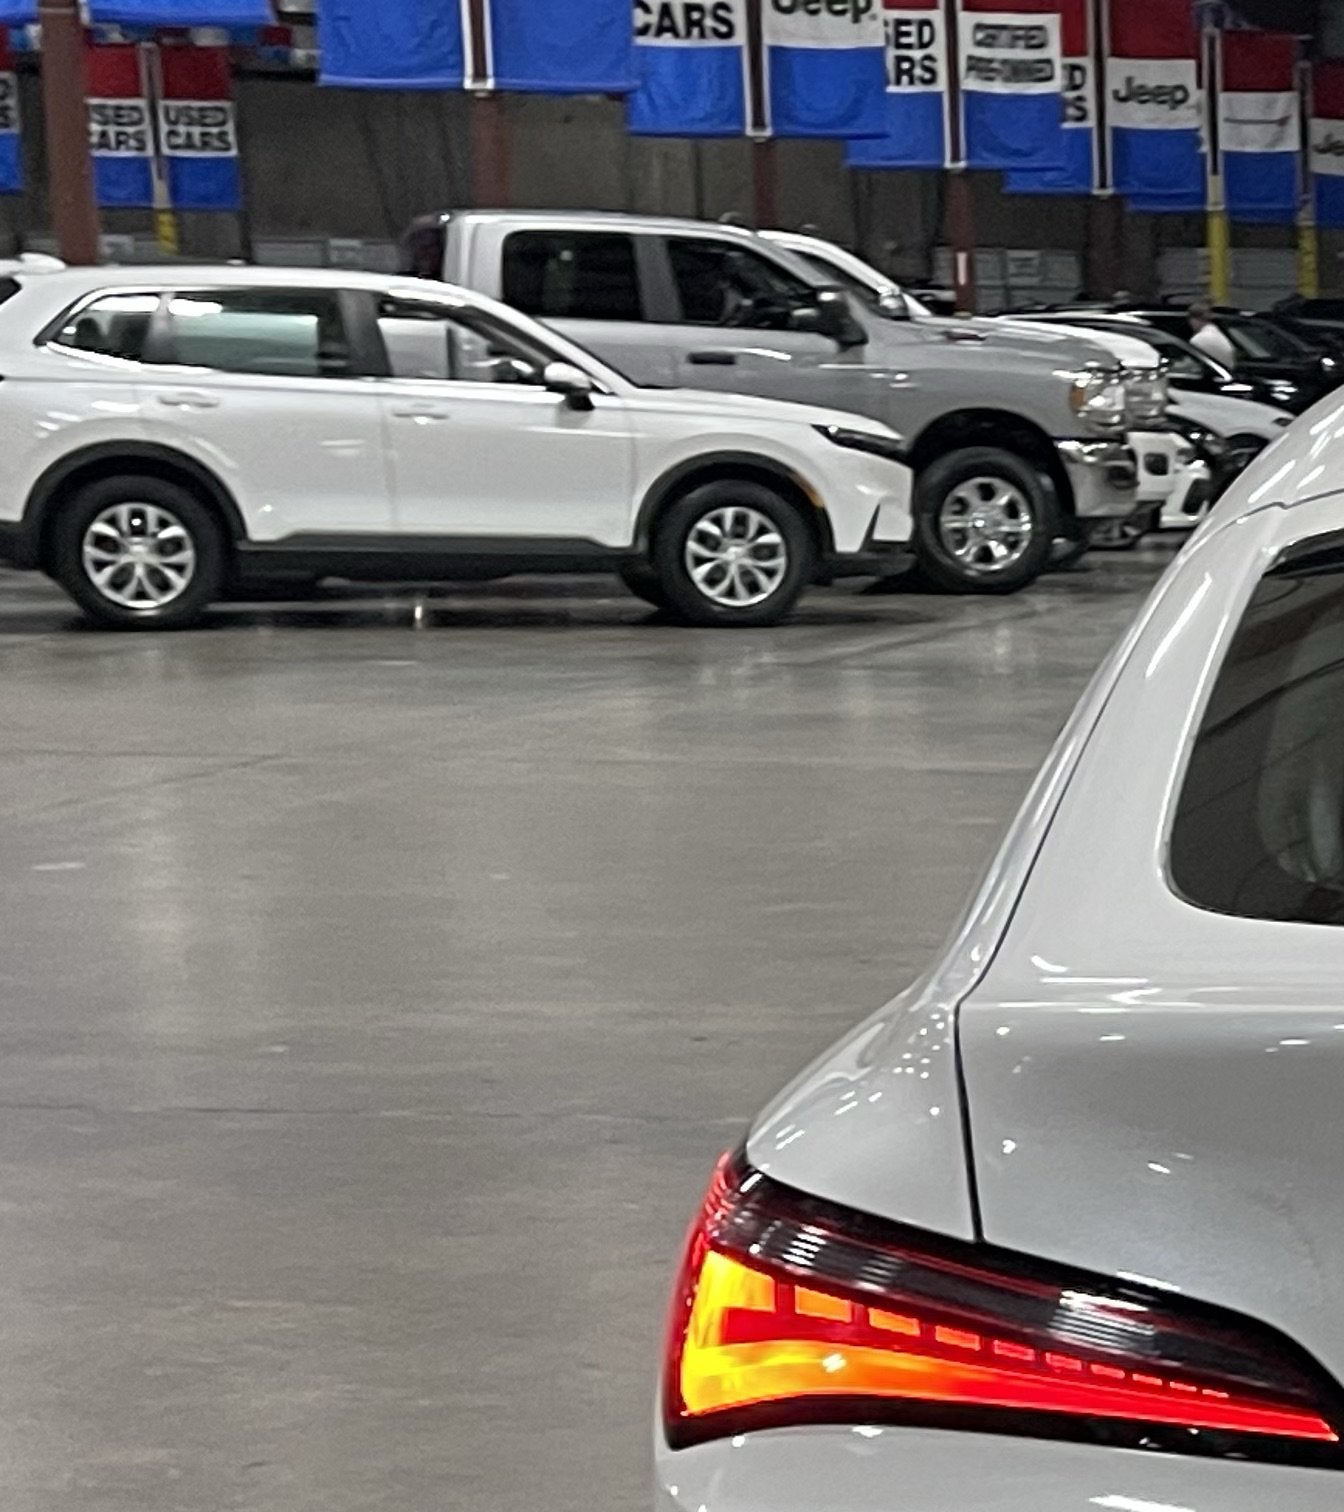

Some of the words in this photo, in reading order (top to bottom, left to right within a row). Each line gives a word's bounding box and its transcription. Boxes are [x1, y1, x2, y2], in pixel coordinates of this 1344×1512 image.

[634, 1, 735, 39] CARS
[884, 18, 935, 49] ED
[894, 54, 937, 85] RS
[1112, 76, 1190, 110] Jeep
[89, 105, 145, 126] SED
[164, 106, 228, 127] USED
[91, 129, 147, 151] ARS
[165, 130, 231, 151] CARS
